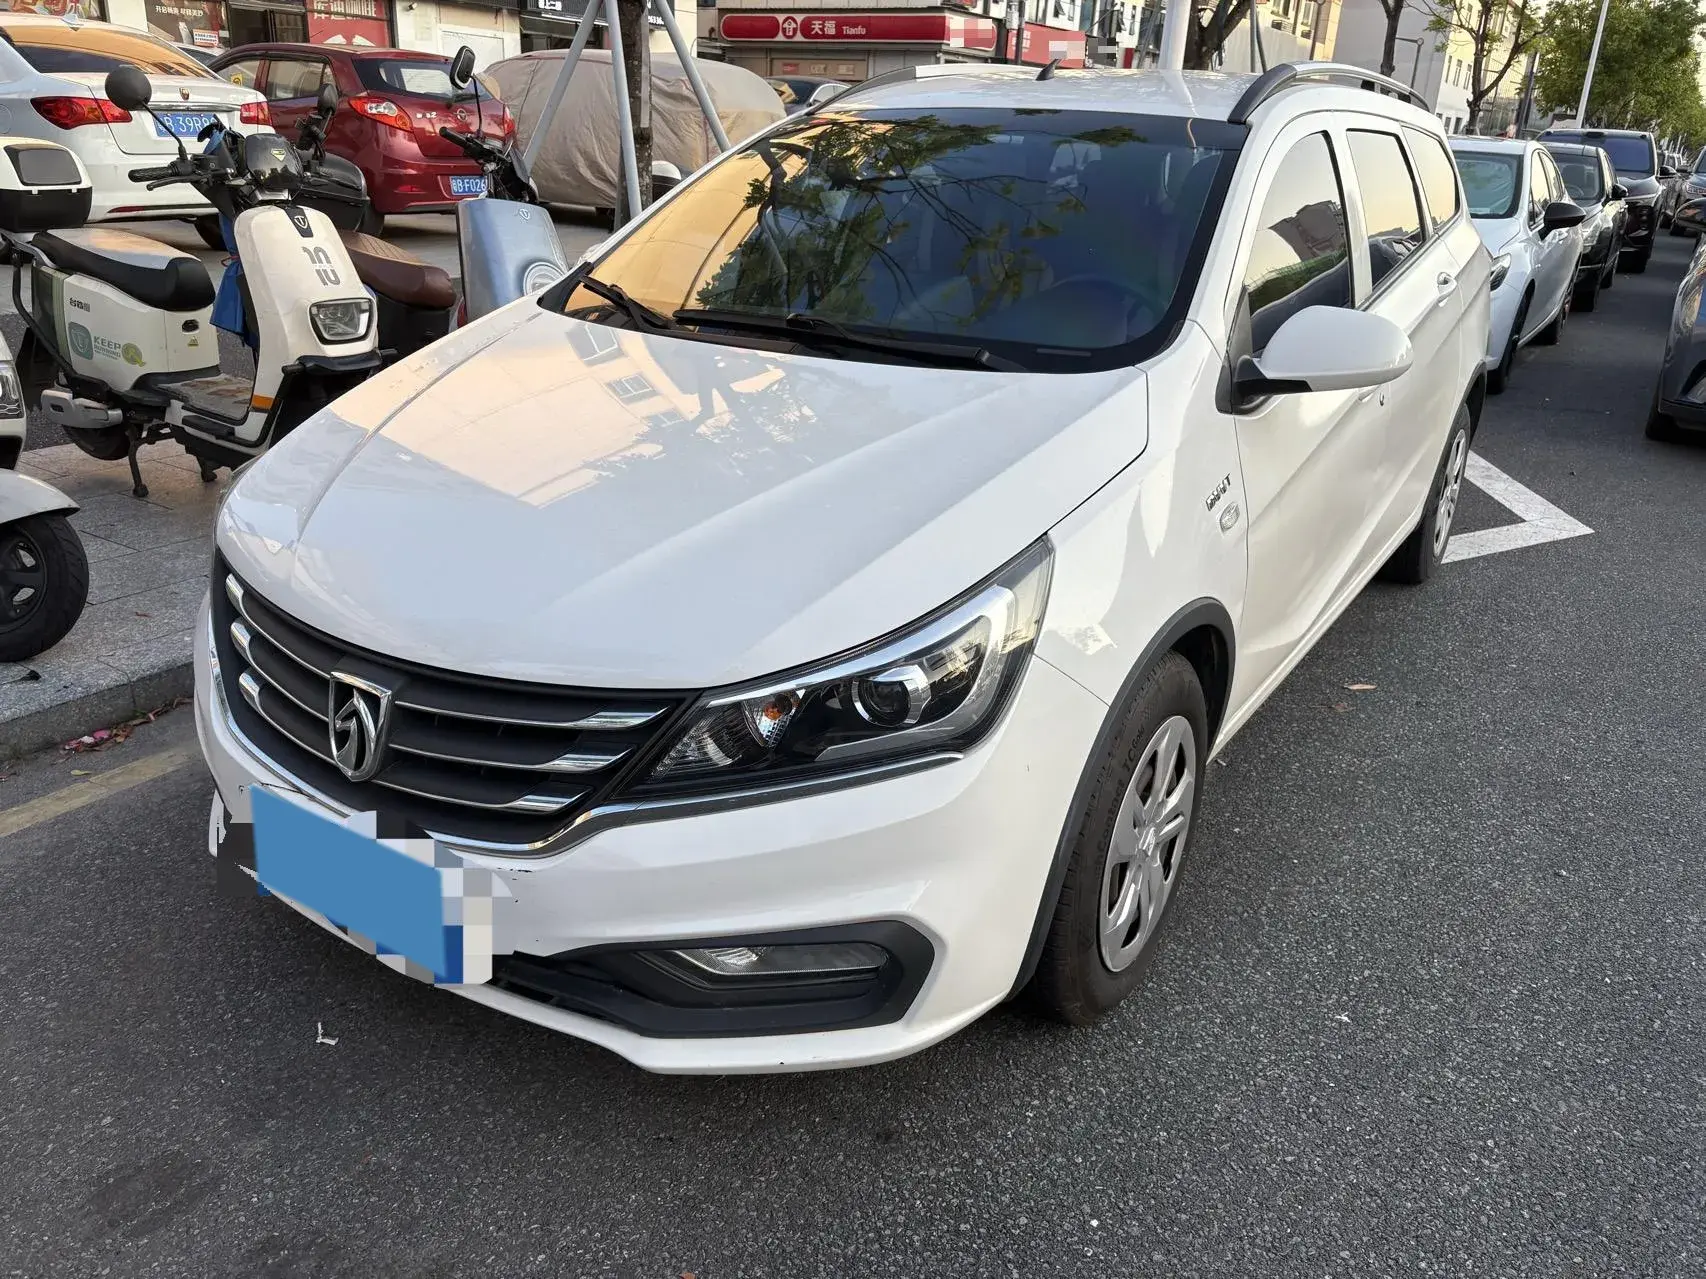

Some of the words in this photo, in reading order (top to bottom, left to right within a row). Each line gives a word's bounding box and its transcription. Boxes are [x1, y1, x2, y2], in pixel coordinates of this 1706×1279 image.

[811, 20, 836, 35] 天福
[841, 25, 866, 35] Tianfu
[93, 335, 121, 350] KEEP
